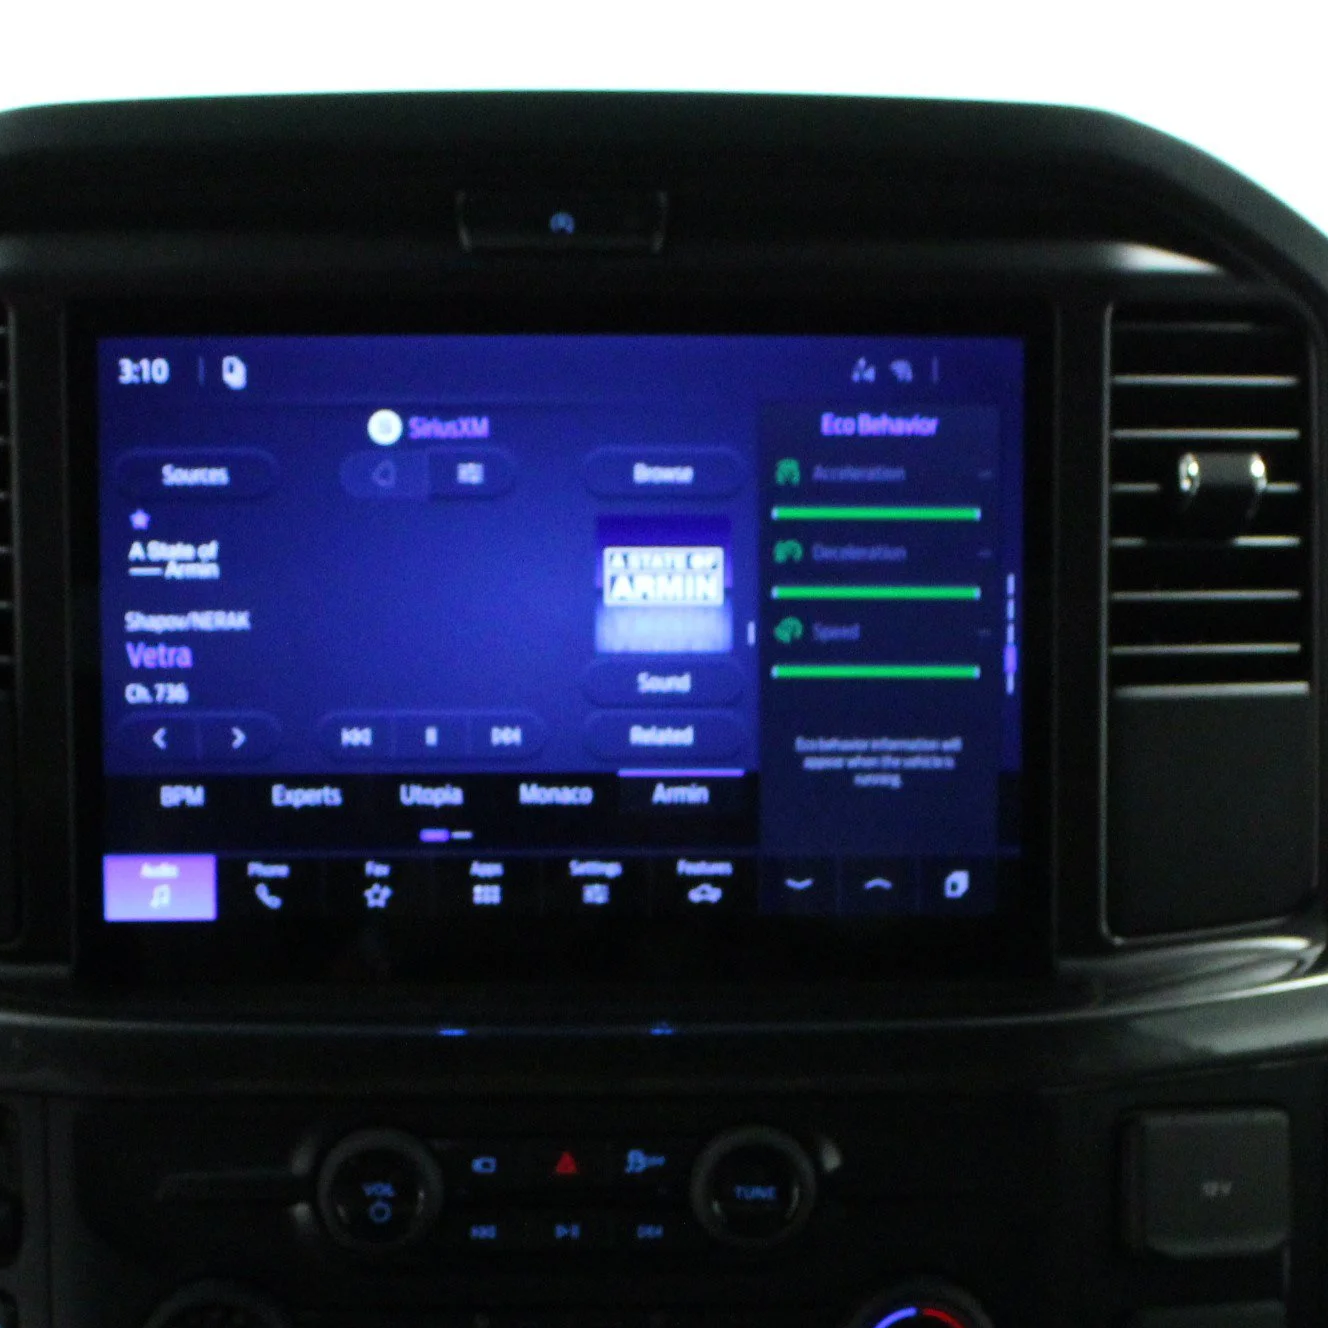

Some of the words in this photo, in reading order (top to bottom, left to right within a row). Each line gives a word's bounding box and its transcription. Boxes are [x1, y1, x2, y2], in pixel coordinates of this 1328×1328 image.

[119, 358, 169, 384] 3:10
[408, 416, 489, 438] SiriusXM
[821, 412, 856, 436] Eco
[858, 412, 938, 436] Behavior
[162, 464, 229, 486] Sources
[633, 463, 694, 484] Browse
[611, 573, 718, 601] ARMIN
[126, 642, 192, 668] Vetra
[637, 672, 691, 693] Sound
[629, 725, 694, 746] Related
[160, 785, 204, 807] BPM
[271, 784, 342, 808] Experts
[400, 784, 463, 807] Utopia
[519, 783, 593, 805] Monaco
[652, 783, 709, 804] Armin
